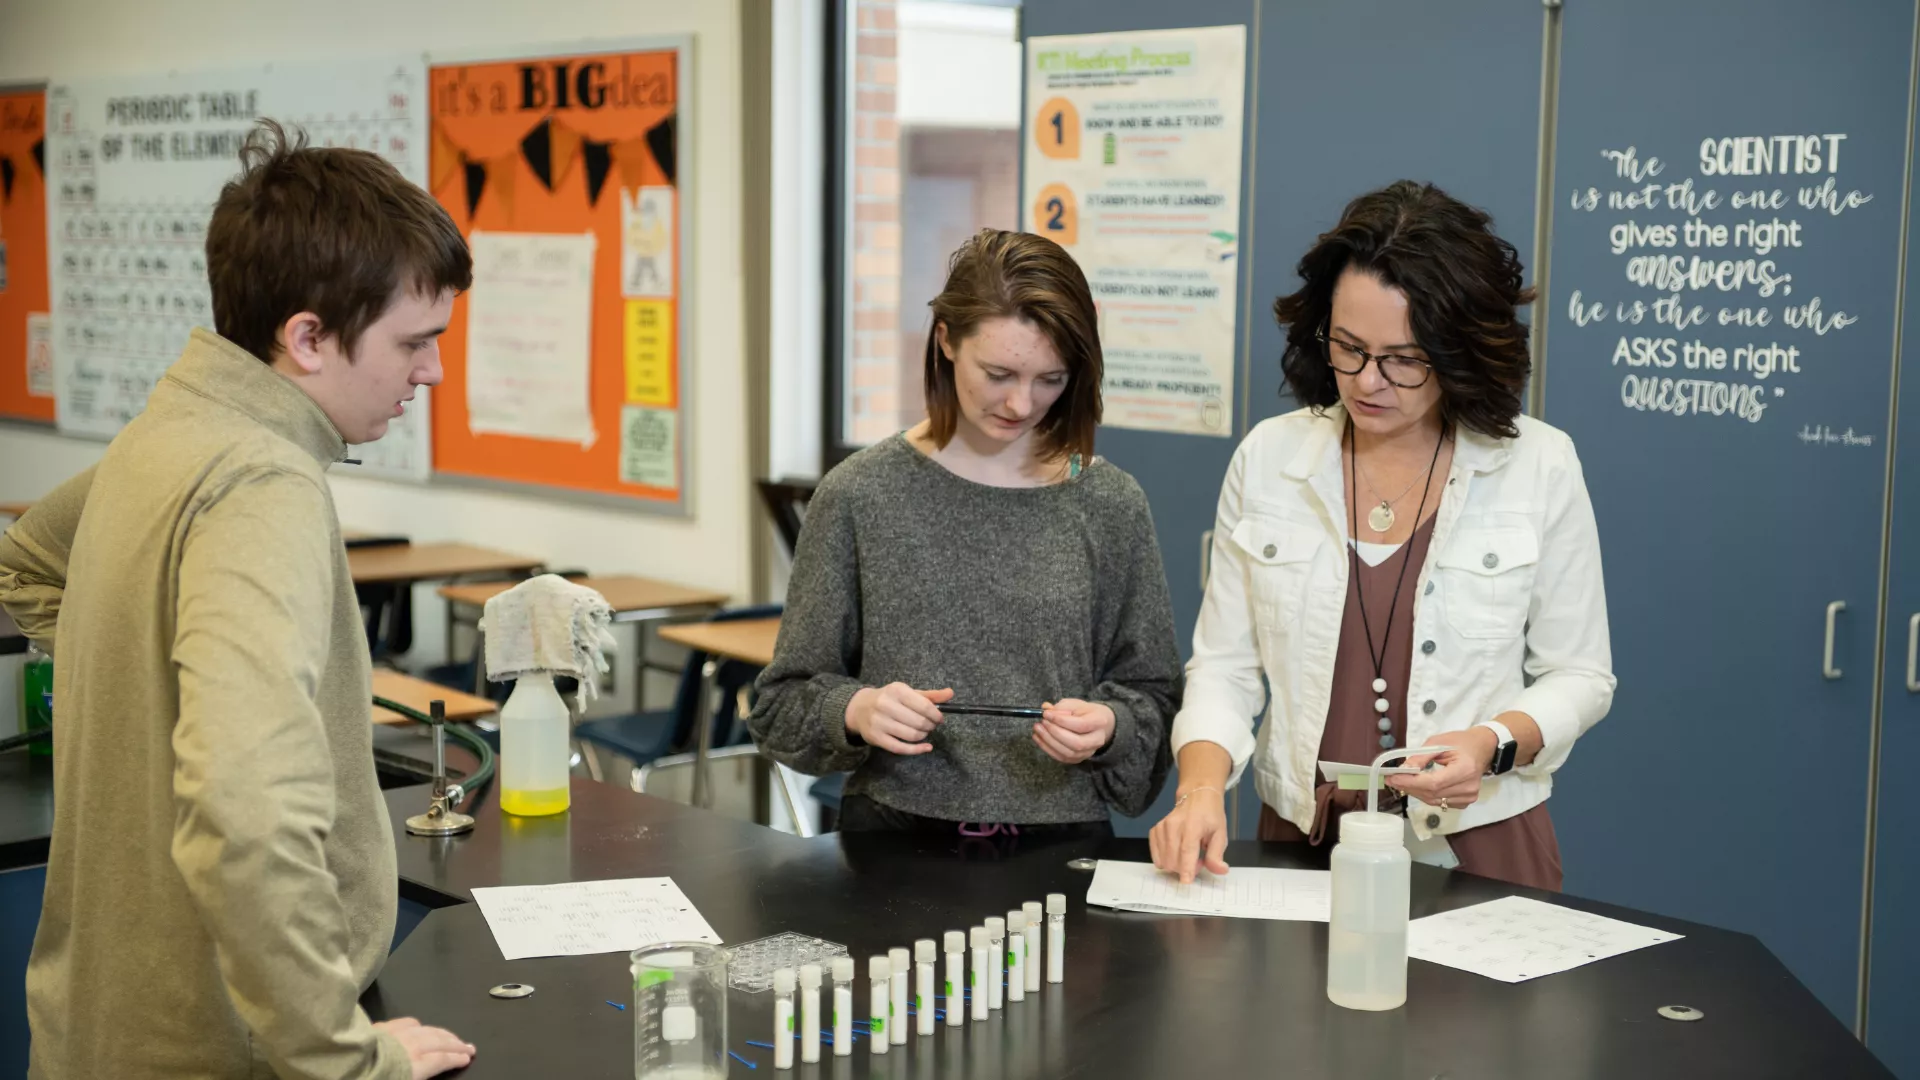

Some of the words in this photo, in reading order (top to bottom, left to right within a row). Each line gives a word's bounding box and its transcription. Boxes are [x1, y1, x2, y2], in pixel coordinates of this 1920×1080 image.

[106, 94, 192, 125] PERIODIC
[198, 88, 259, 121] TABLE
[489, 80, 508, 116] a
[518, 61, 608, 111] BIG
[102, 132, 123, 163] OF
[130, 131, 165, 162] THE
[1050, 111, 1064, 145] 1
[1700, 133, 1847, 176] SCIENTIST
[1046, 196, 1066, 231] 2
[1570, 186, 1603, 212] is
[1608, 183, 1662, 210] not
[1663, 177, 1724, 216] the
[1730, 187, 1791, 211] one
[1798, 176, 1875, 216] who
[1609, 219, 1678, 255] gives
[1683, 217, 1729, 248] the
[1734, 217, 1803, 255] right
[1568, 289, 1609, 328] he
[1616, 298, 1648, 325] is
[1652, 293, 1711, 331] the
[1717, 305, 1774, 328] one
[1783, 296, 1860, 336] who
[1612, 336, 1678, 369] ASKS
[1682, 339, 1727, 370] the
[1733, 341, 1802, 380] right
